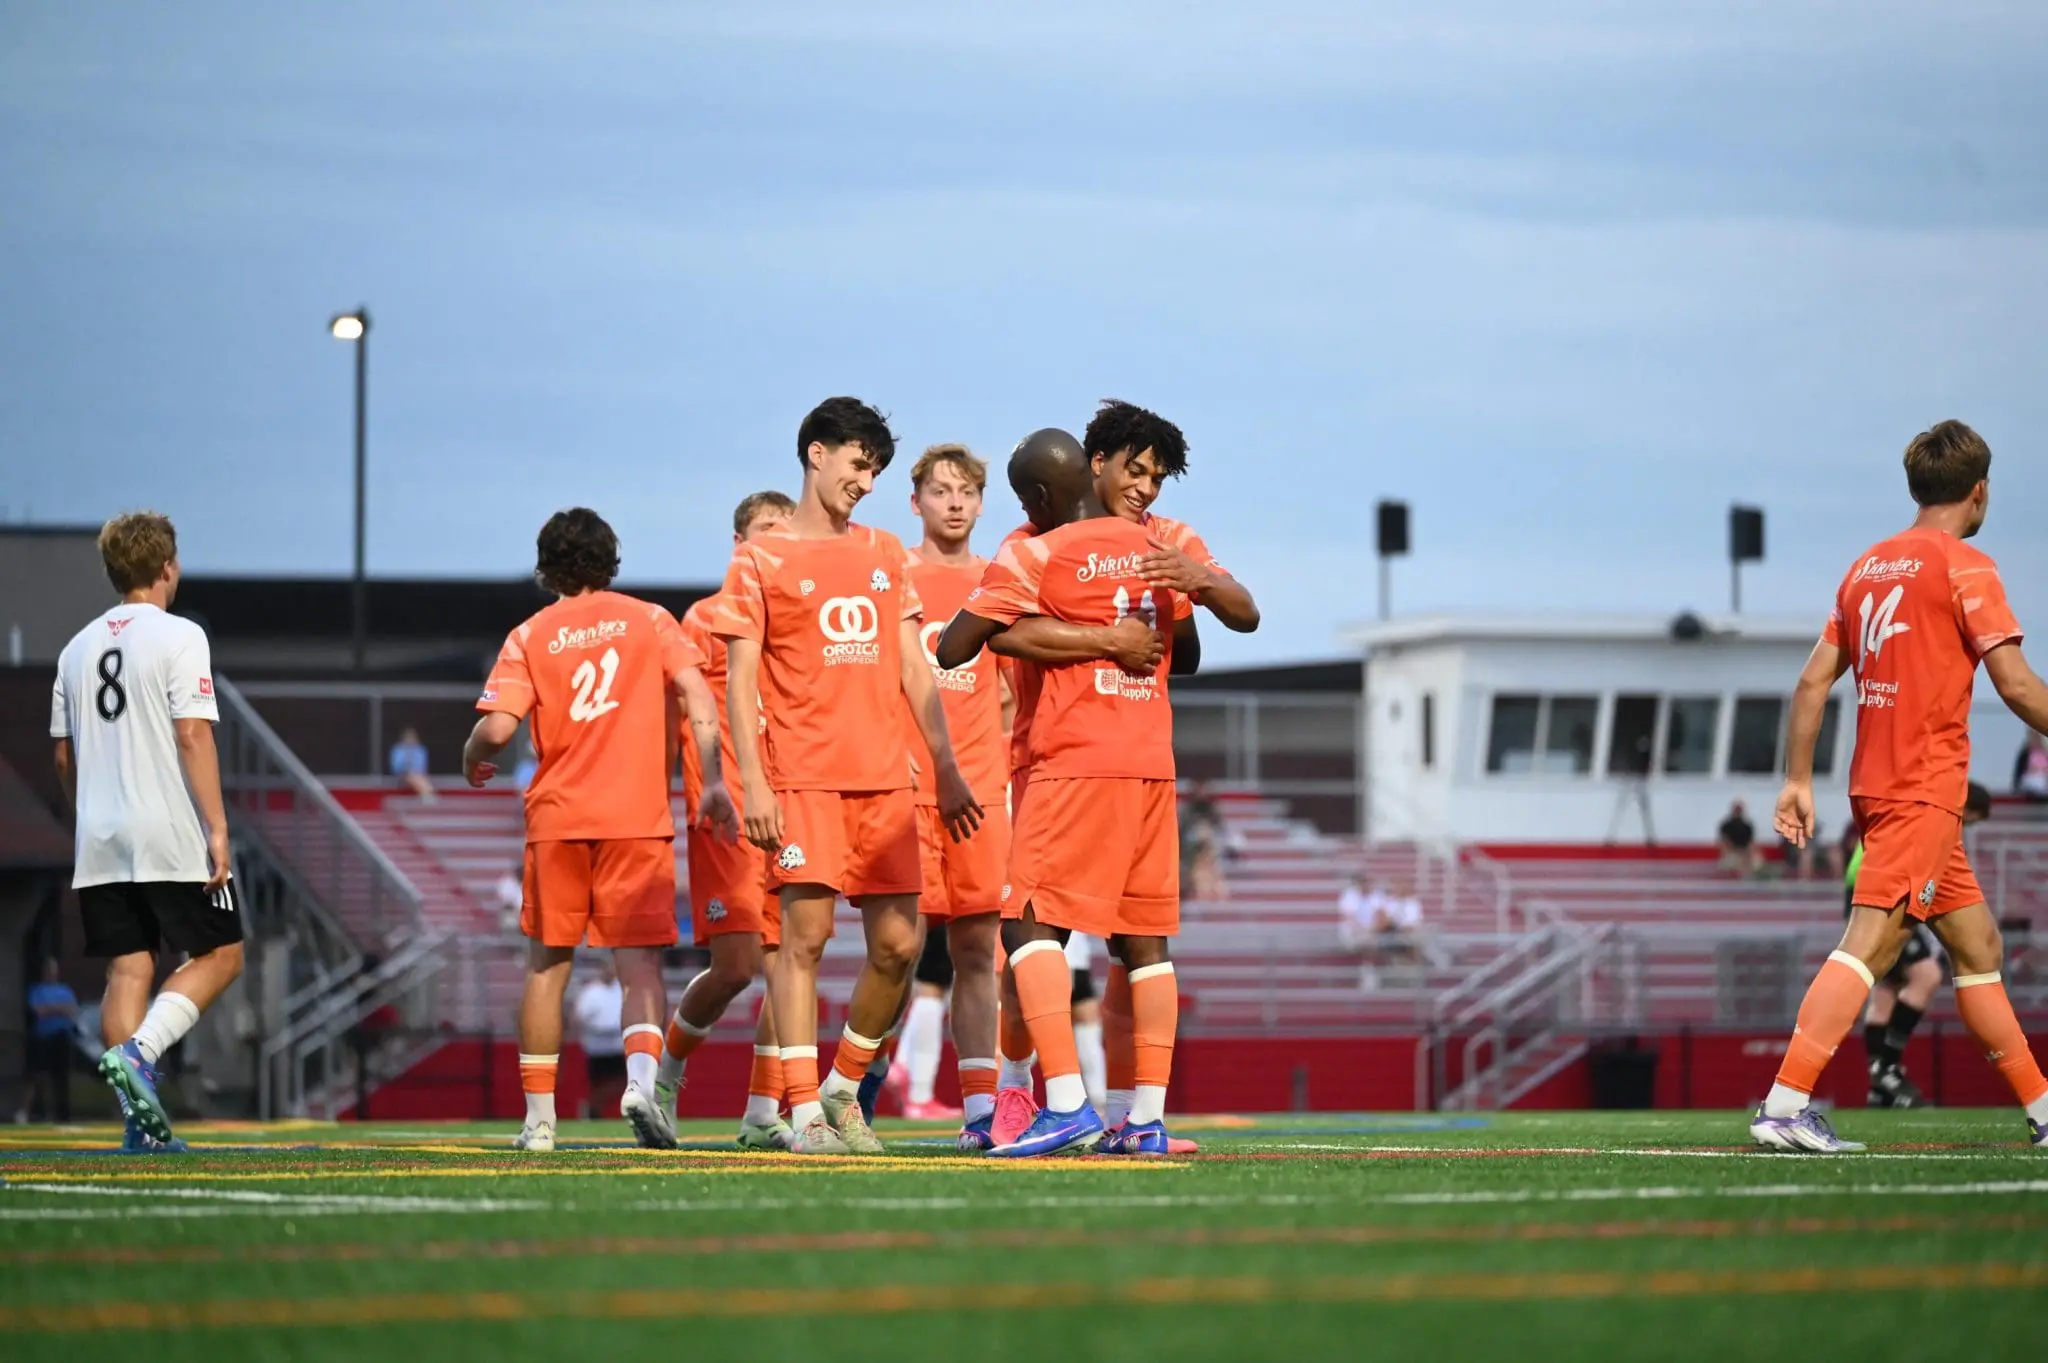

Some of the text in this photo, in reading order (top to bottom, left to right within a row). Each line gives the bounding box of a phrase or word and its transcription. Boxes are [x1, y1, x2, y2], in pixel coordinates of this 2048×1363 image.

[1077, 551, 1142, 582] SHRIVE
[822, 643, 880, 658] OROZCO
[1857, 584, 1913, 674] 14
[96, 647, 127, 723] 8
[569, 647, 621, 722] 21
